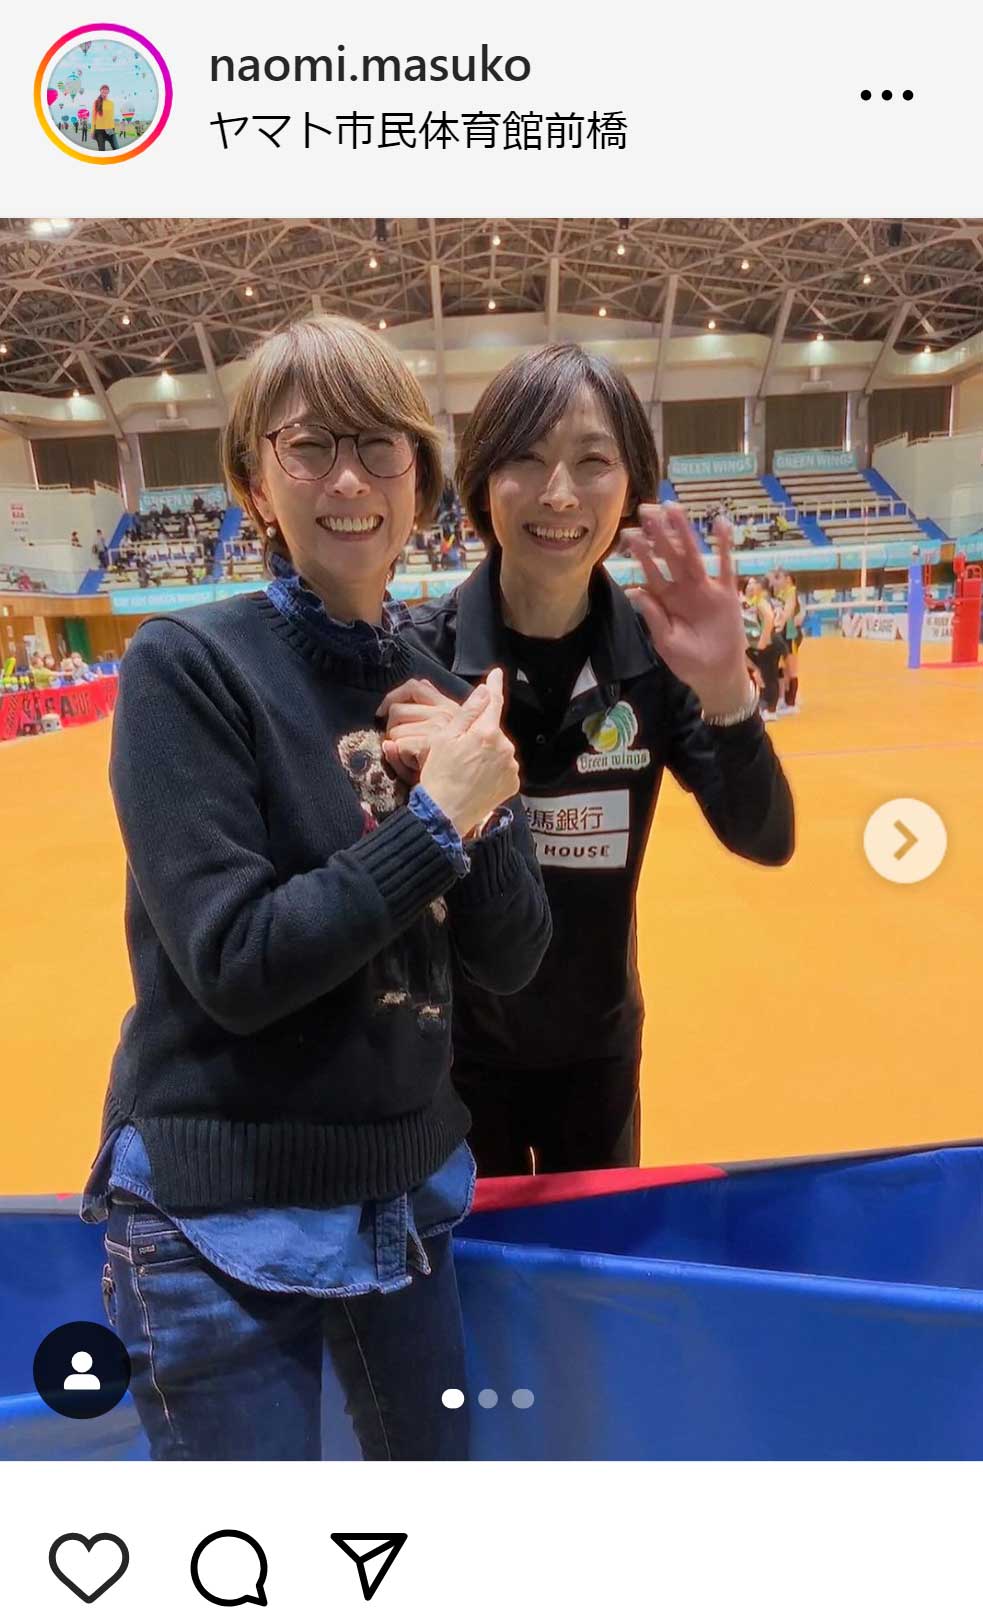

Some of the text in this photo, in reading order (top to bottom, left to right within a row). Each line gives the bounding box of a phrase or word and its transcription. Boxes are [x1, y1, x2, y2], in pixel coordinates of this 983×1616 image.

[672, 457, 752, 475] GREEN WINGS
[777, 452, 853, 468] GREEN WINGS
[580, 755, 609, 770] Green
[544, 844, 611, 858] HOUSE
